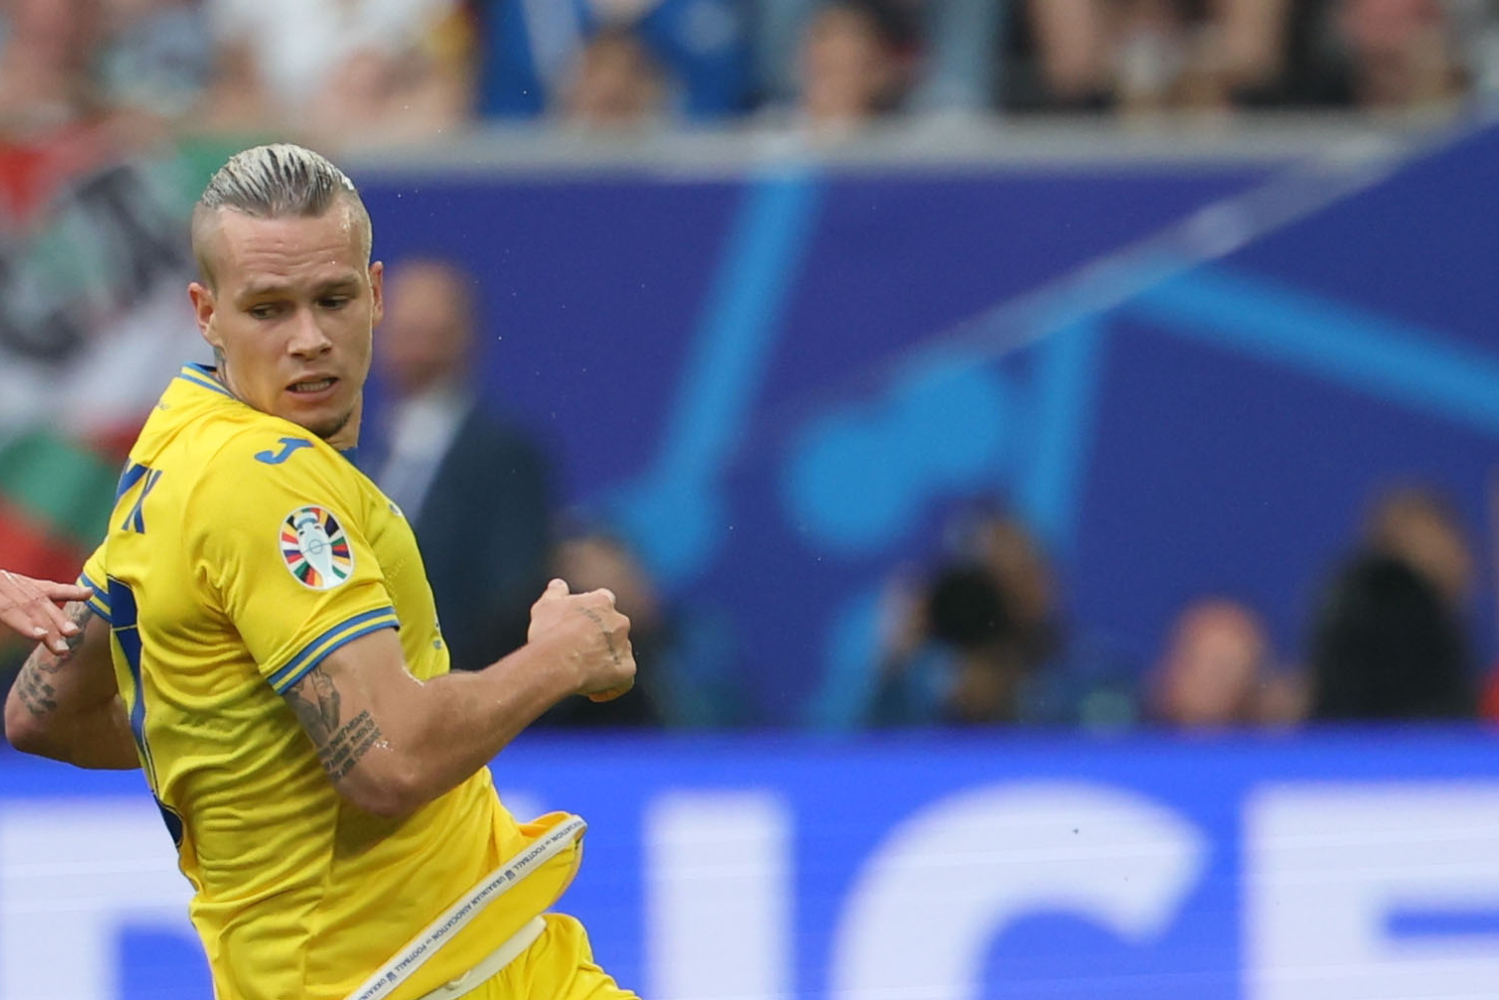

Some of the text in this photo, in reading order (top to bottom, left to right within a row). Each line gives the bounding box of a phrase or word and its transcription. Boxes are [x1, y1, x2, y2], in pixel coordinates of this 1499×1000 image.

[513, 844, 546, 871] FOOTBALL
[471, 876, 505, 906] UKRAINIAN
[432, 903, 472, 941] ASSOCIATION
[395, 944, 427, 972] FOOTBALL
